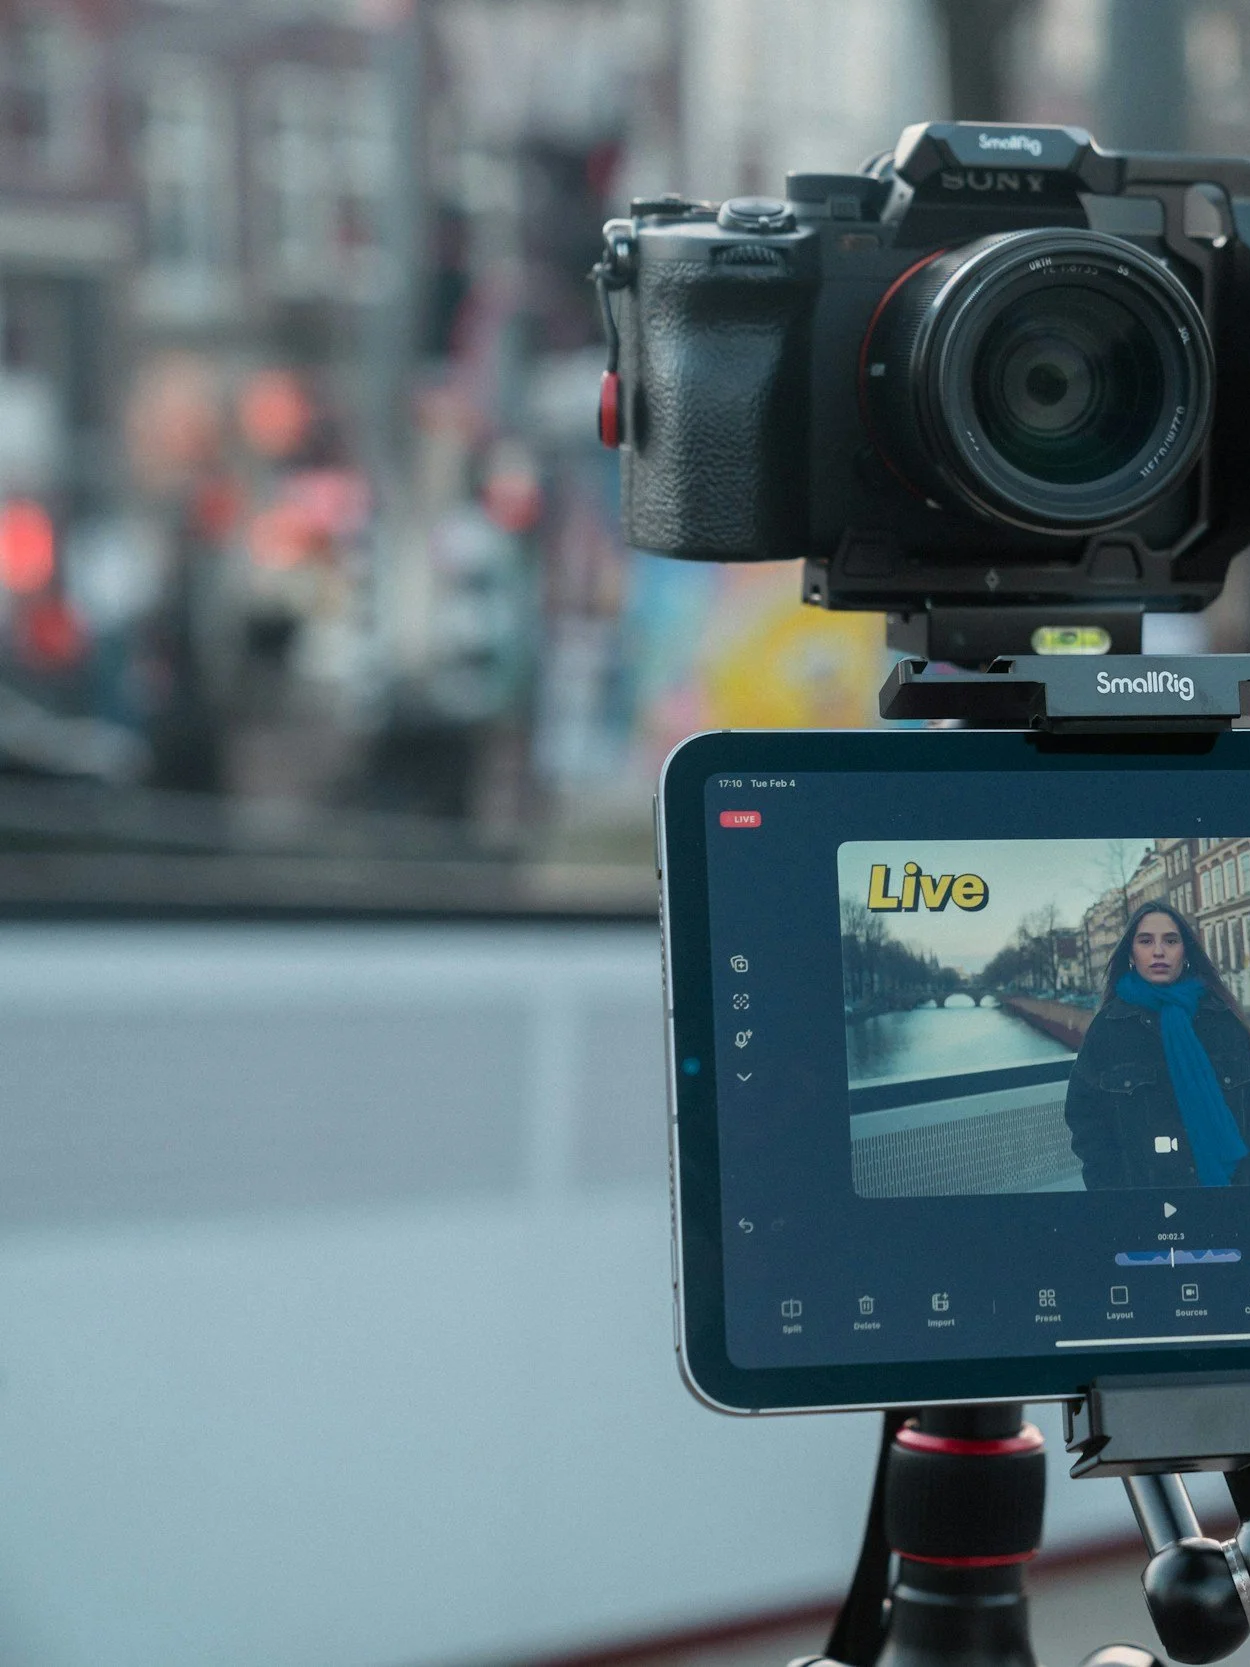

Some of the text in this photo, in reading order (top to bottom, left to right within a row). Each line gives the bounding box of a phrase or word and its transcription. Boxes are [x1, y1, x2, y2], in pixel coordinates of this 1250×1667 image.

[979, 133, 1042, 156] SmallRig
[941, 172, 1042, 192] SONY
[1097, 671, 1195, 701] SmallRig
[718, 779, 796, 788] 17:10 Tue Feb 4
[734, 815, 756, 824] LIVE
[867, 862, 989, 912] Live
[1157, 1232, 1185, 1241] 00:02.3
[1106, 1311, 1134, 1321] Layout
[1175, 1308, 1208, 1317] Sources
[927, 1318, 955, 1329] Import
[1035, 1314, 1062, 1323] Preset
[782, 1324, 802, 1335] Split
[853, 1321, 881, 1331] Delete
